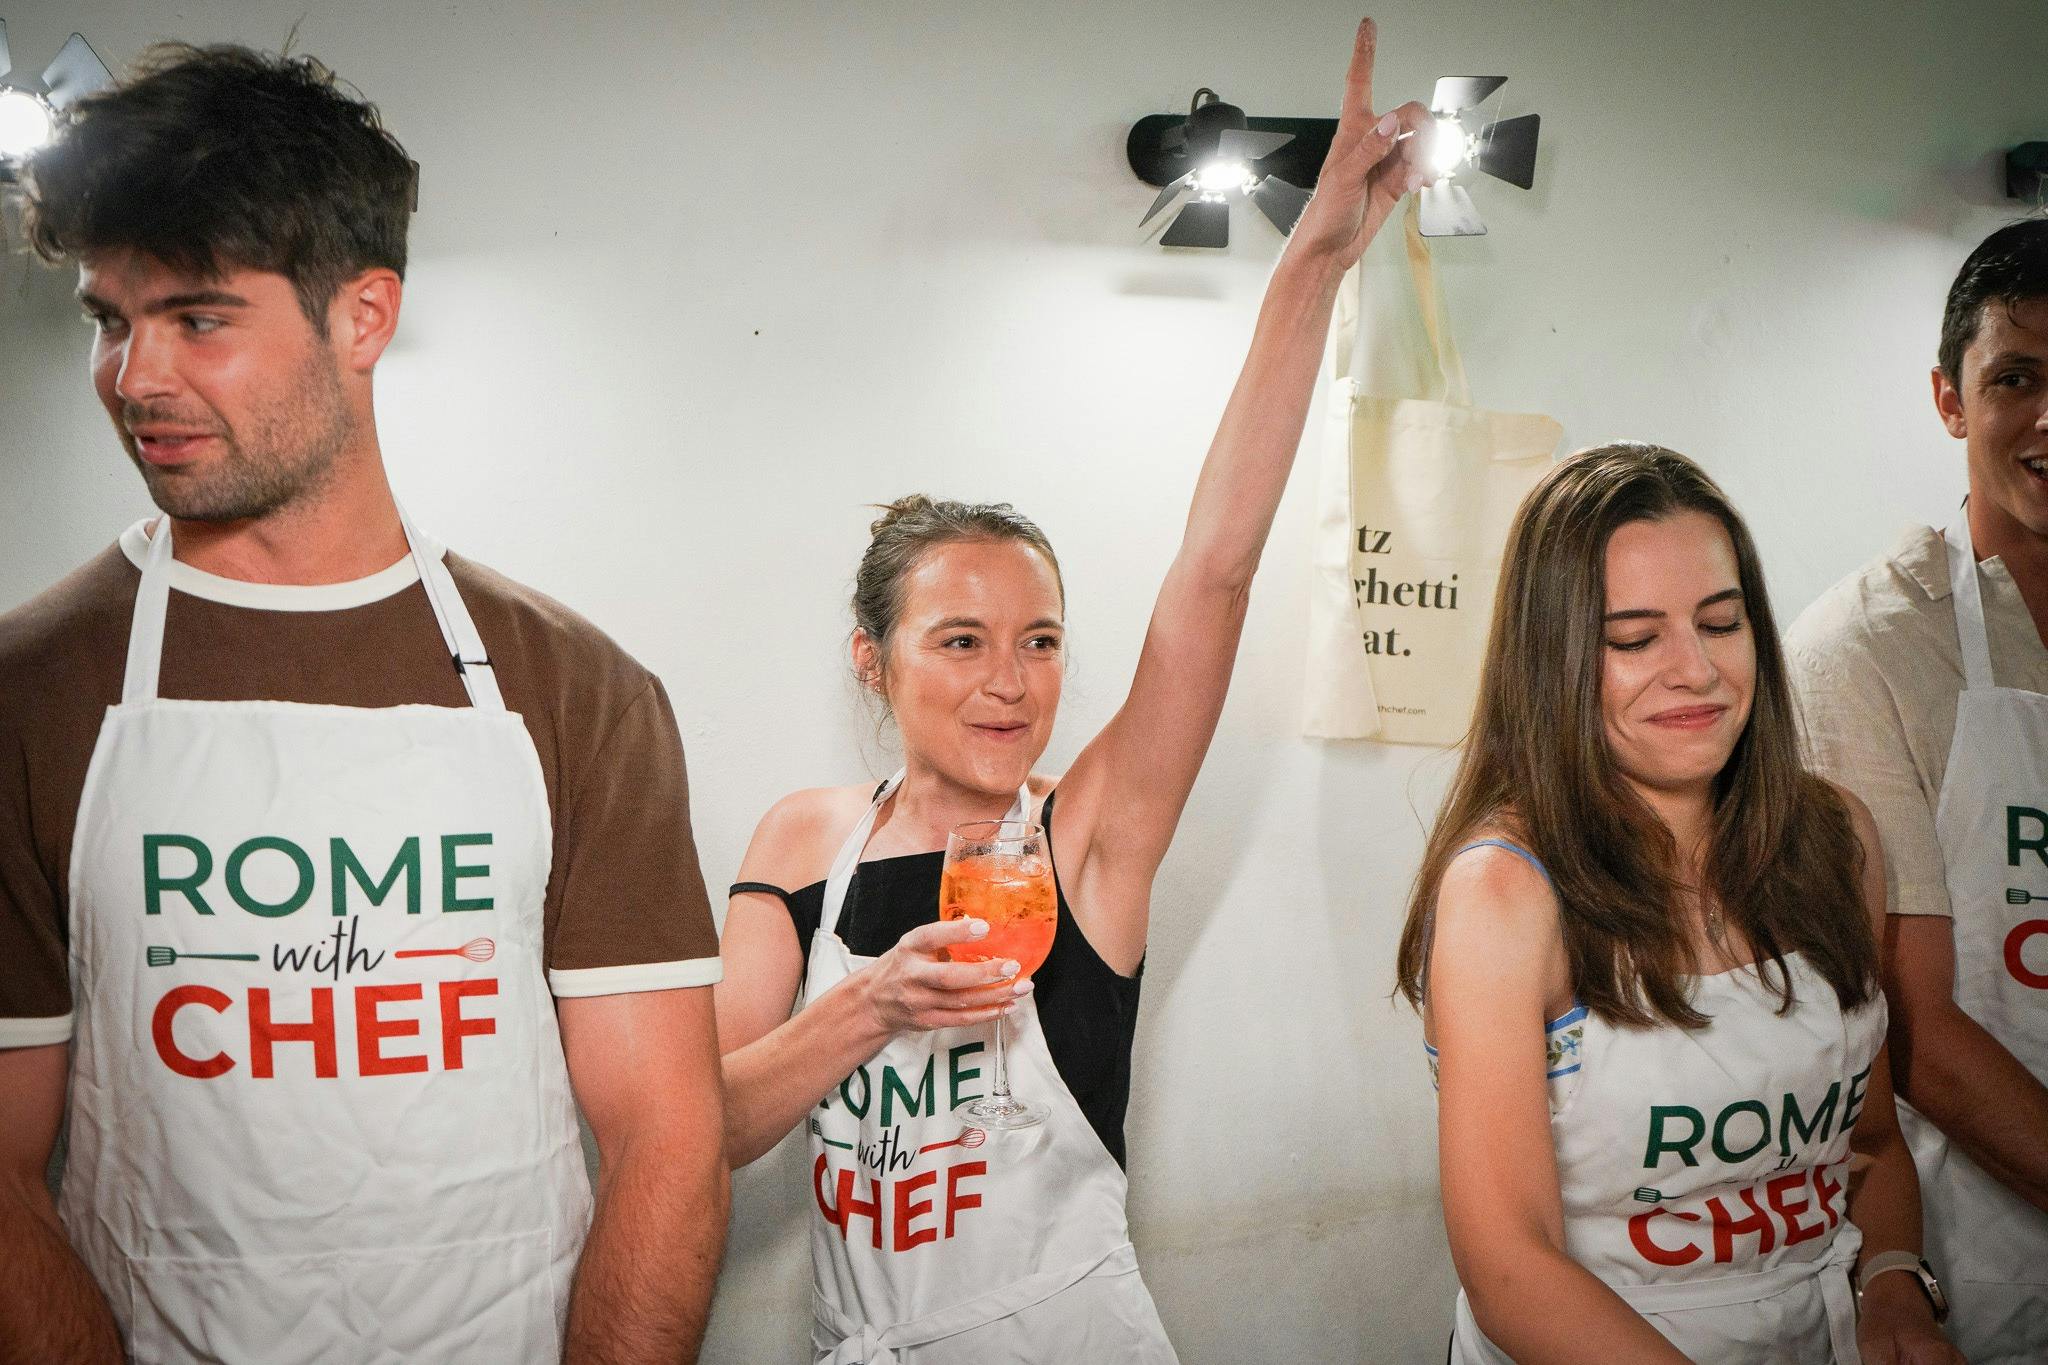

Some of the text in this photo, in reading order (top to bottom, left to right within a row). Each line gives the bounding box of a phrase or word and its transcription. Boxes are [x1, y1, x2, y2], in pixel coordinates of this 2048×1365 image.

[143, 833, 495, 918] ROME
[273, 915, 385, 981] with
[151, 978, 499, 1079] CHEF
[818, 1041, 985, 1127] OME
[1643, 1063, 1871, 1169] ROME
[857, 1124, 916, 1177] with
[814, 1152, 987, 1252] CHEF
[1628, 1160, 1846, 1266] CHEF
